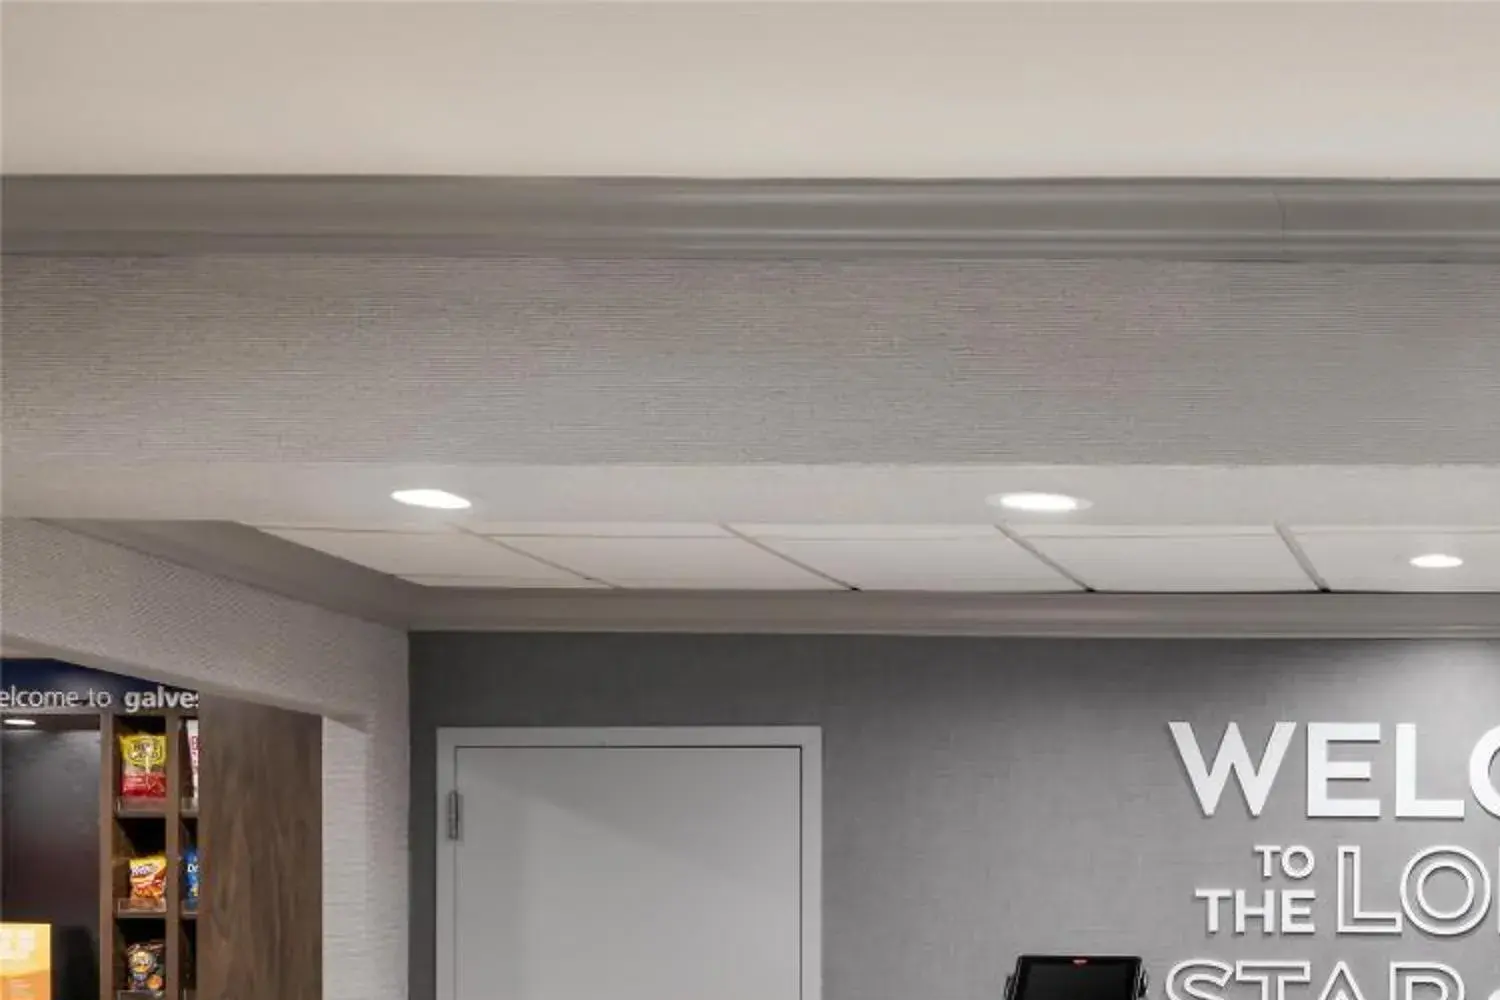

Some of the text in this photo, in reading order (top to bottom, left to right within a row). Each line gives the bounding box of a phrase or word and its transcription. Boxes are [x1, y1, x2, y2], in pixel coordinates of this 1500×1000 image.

[87, 687, 111, 708] to
[1254, 844, 1315, 878] TO
[1195, 888, 1316, 934] THE
